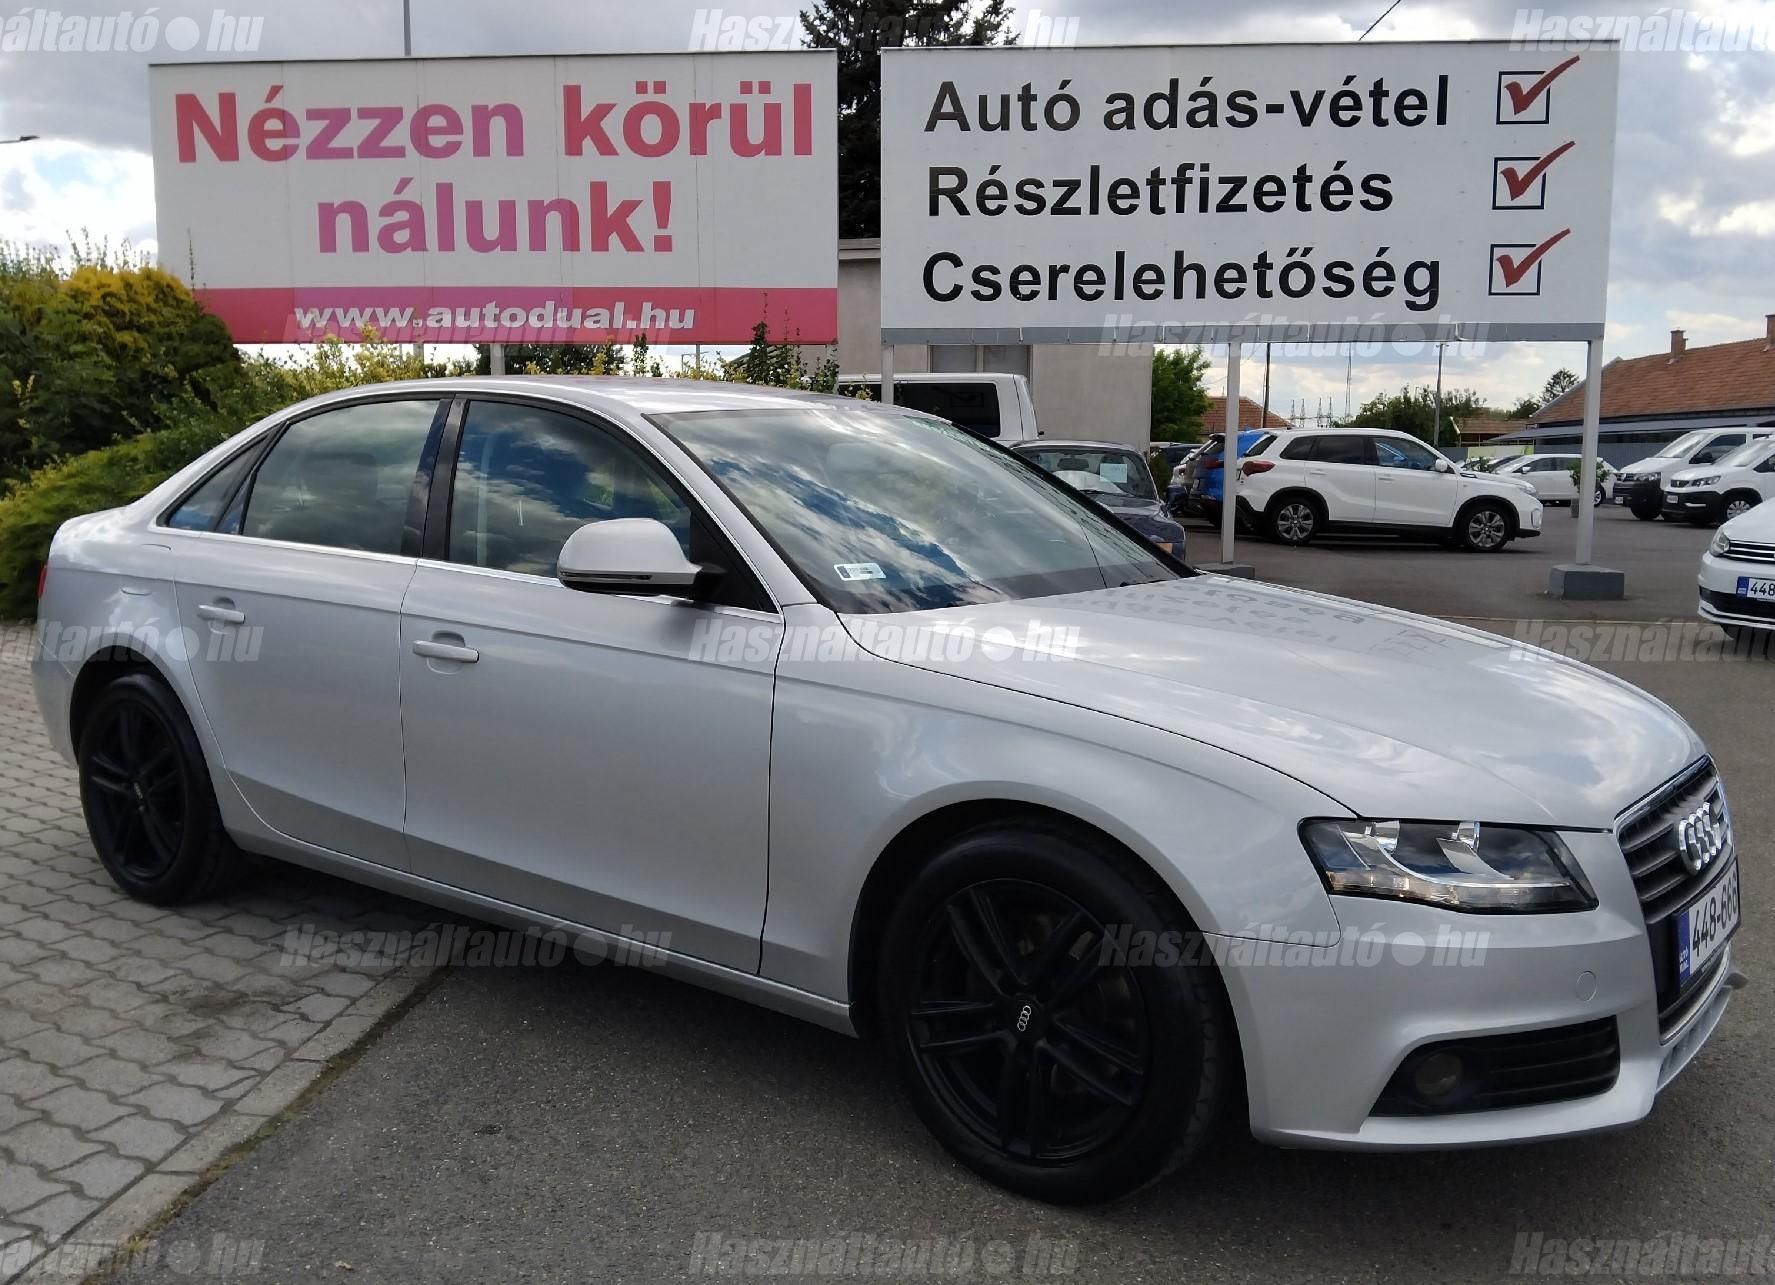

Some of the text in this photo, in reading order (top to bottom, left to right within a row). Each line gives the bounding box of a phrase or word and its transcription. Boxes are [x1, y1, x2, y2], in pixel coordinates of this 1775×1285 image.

[176, 81, 813, 163] Nézzen körül
[923, 74, 1449, 133] Autó adás-vétel
[317, 178, 674, 254] nálunk!
[928, 159, 1393, 217] Részletfizetés
[922, 246, 1440, 312] Cserelehetőség
[296, 300, 695, 329] www.autodual.hu
[1692, 868, 1737, 958] 448-666
